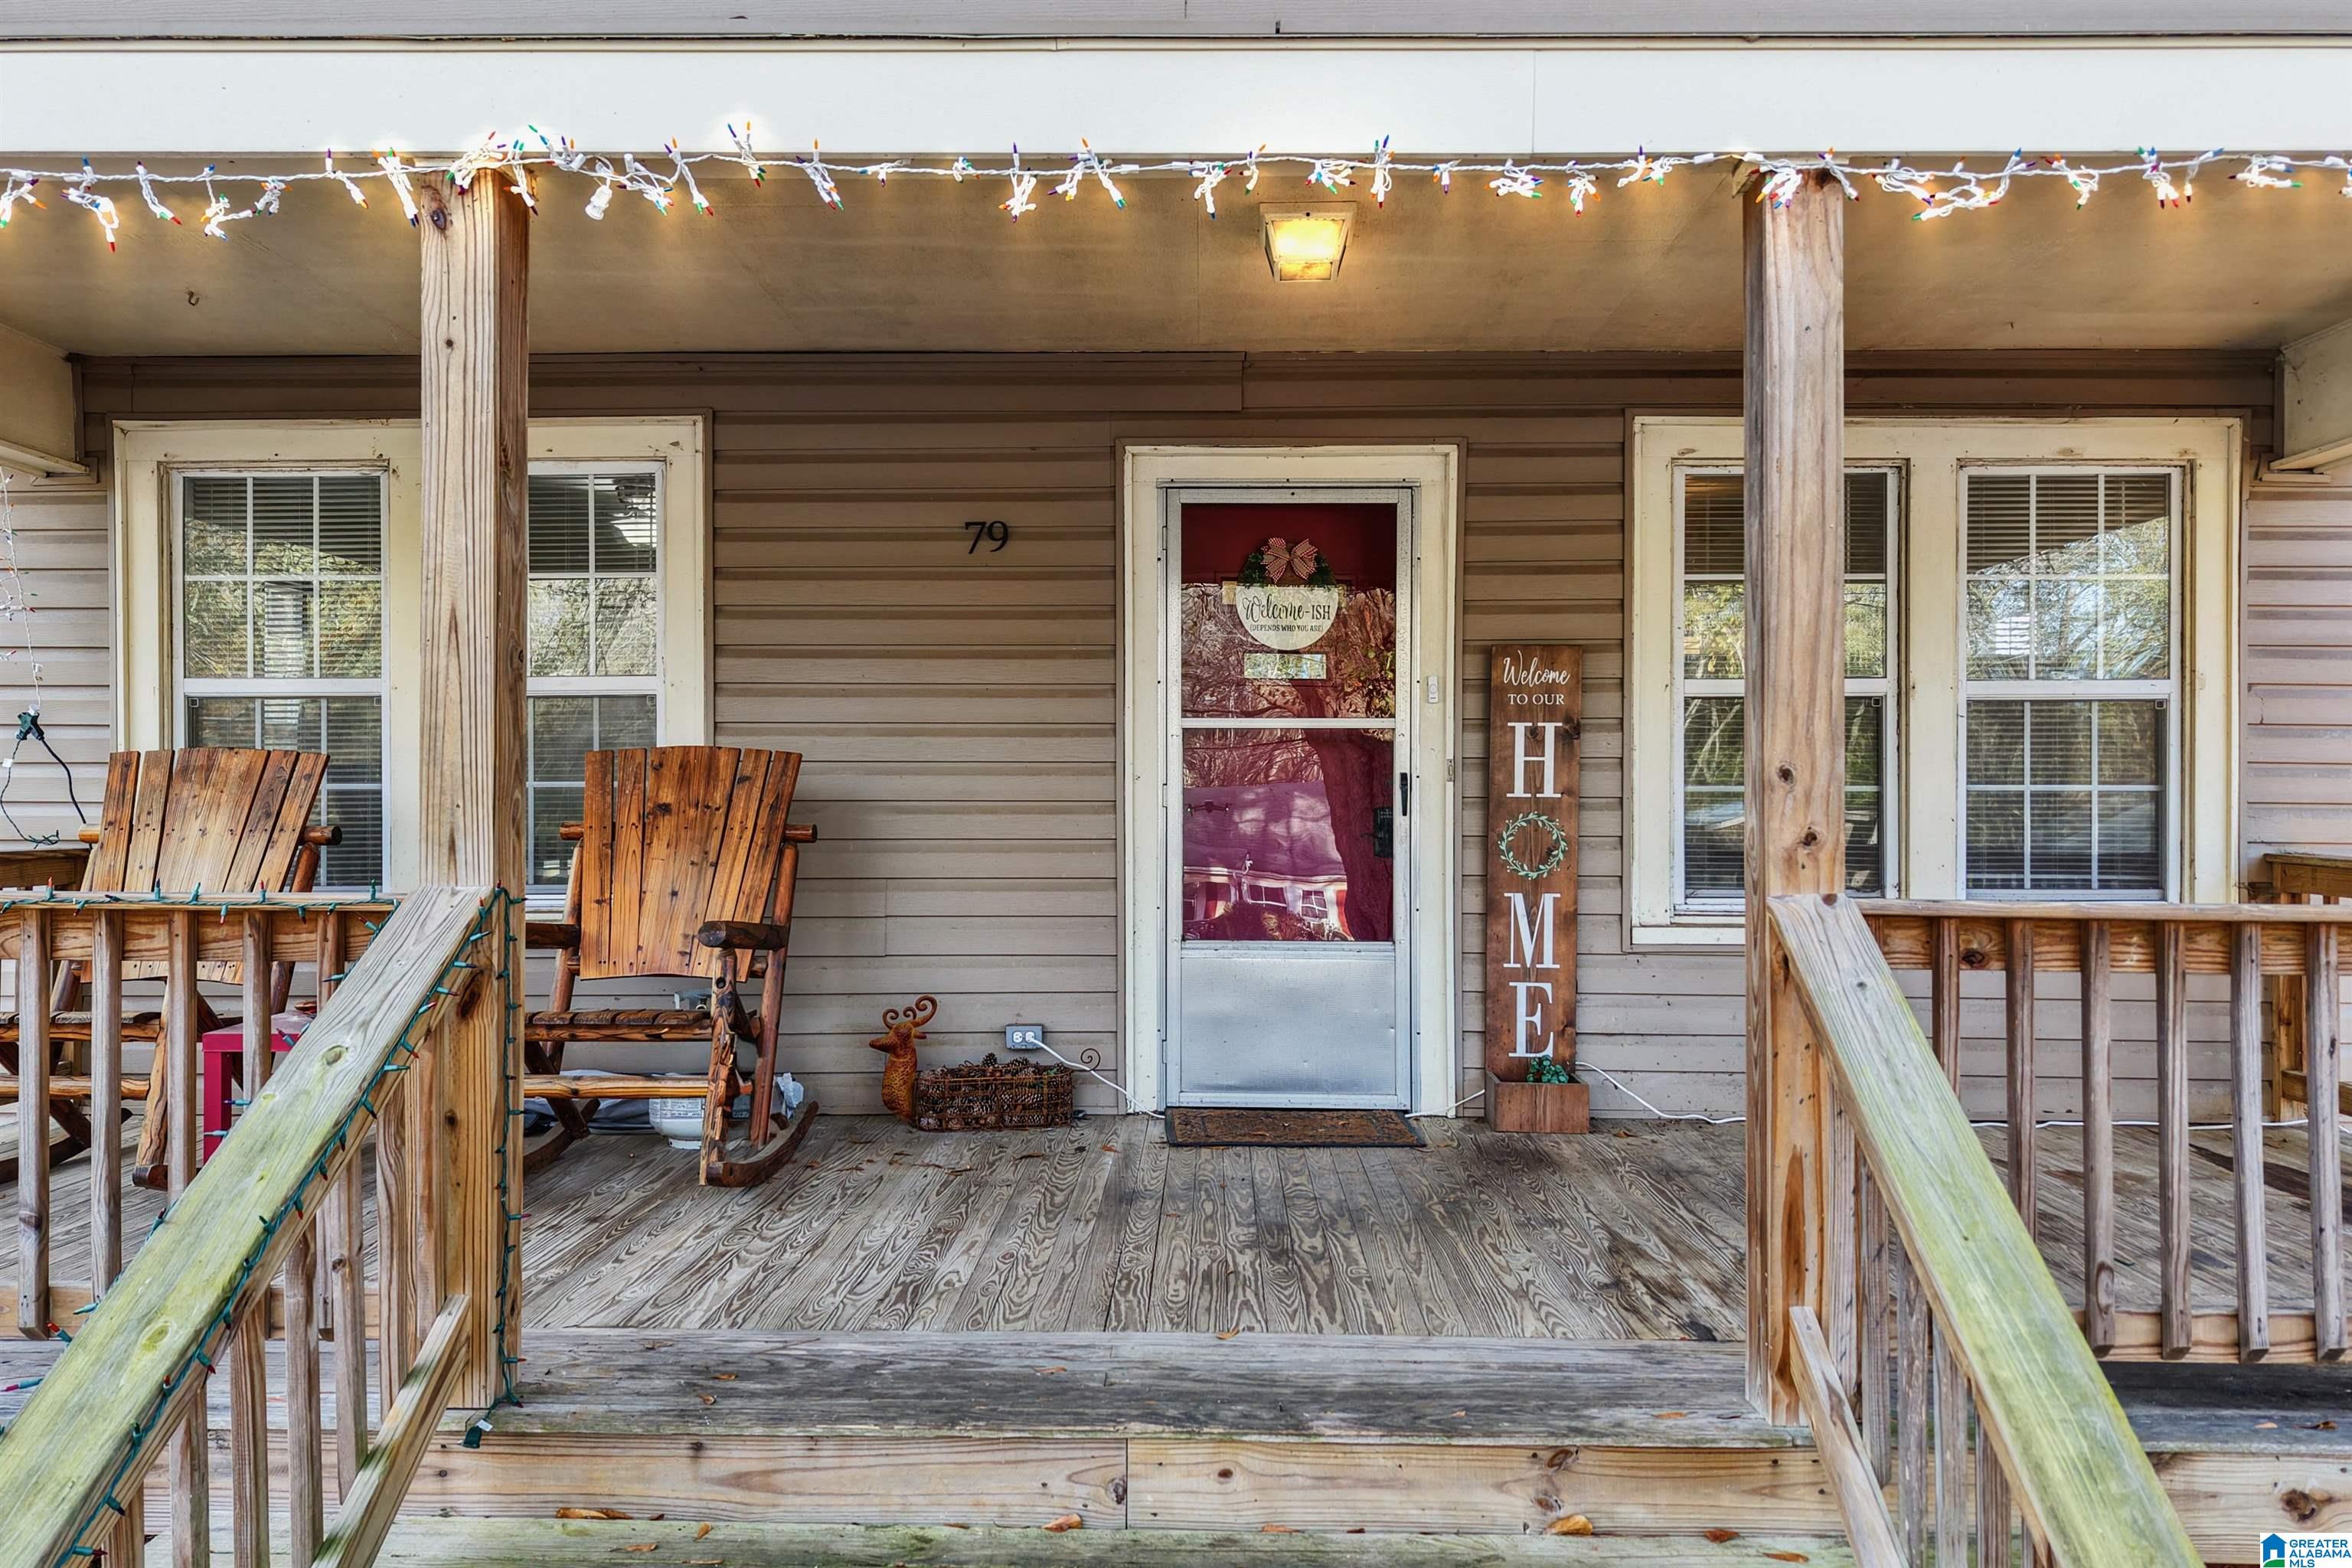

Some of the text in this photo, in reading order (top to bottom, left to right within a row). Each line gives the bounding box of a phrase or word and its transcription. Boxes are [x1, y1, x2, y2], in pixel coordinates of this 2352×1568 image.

[965, 521, 1009, 554] 79
[1250, 624, 1280, 632] (DEPENDS
[1297, 624, 1308, 632] YOU
[1309, 624, 1324, 632] ARE)
[1503, 649, 1570, 688] Welcome
[1508, 694, 1565, 705] TO OUR
